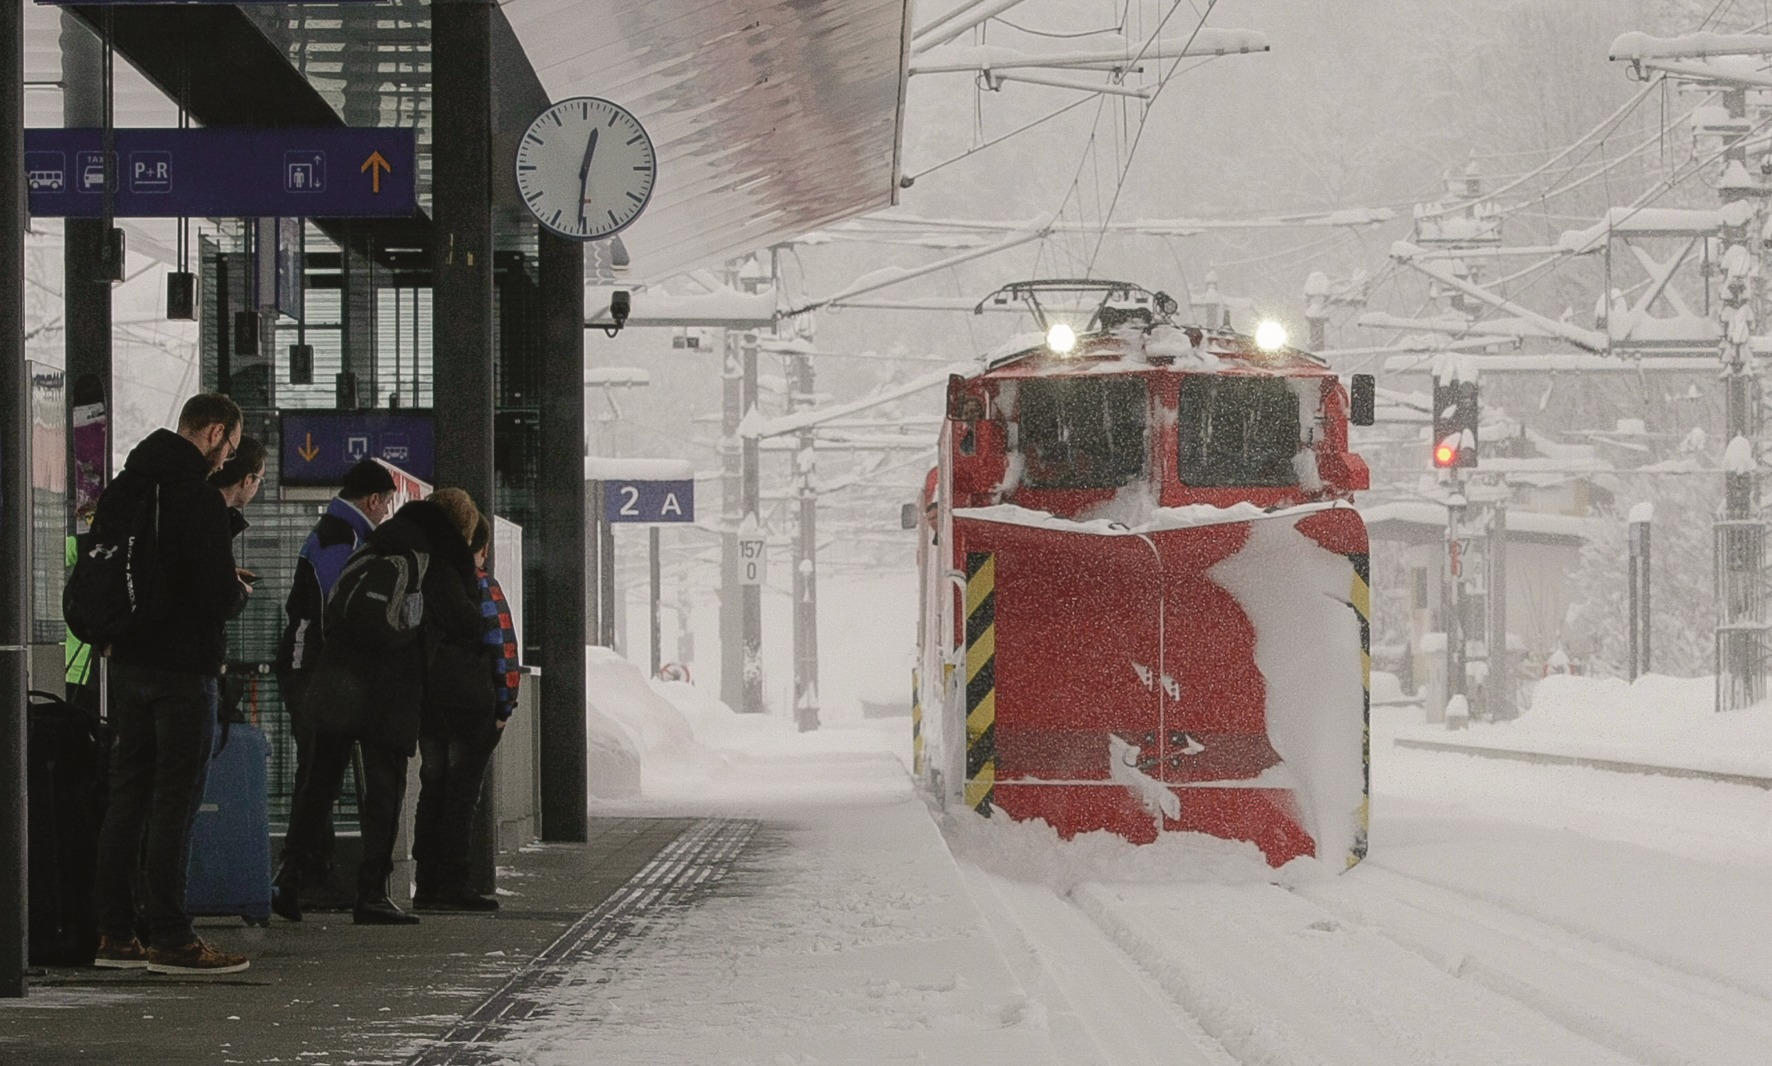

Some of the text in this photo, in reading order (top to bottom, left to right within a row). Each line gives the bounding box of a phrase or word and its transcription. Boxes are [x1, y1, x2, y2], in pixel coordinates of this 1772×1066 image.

[87, 155, 104, 163] TAX
[135, 162, 168, 179] P+R
[620, 486, 682, 516] 2 A
[739, 540, 764, 558] 157
[746, 562, 757, 580] 0
